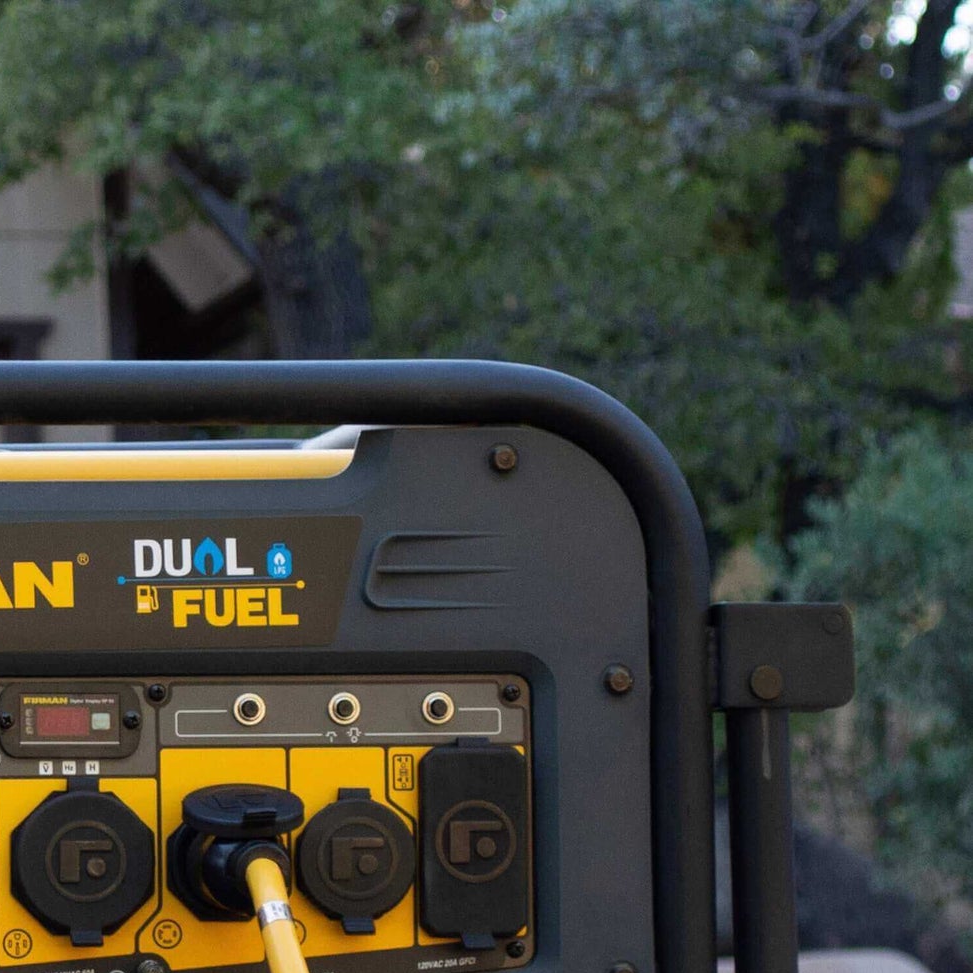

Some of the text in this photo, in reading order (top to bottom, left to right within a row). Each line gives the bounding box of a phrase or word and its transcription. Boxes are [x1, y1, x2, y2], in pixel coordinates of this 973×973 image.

[134, 537, 254, 578] DUAL
[172, 588, 299, 628] FUEL
[418, 957, 476, 970] 120VAC 20A GFCI
